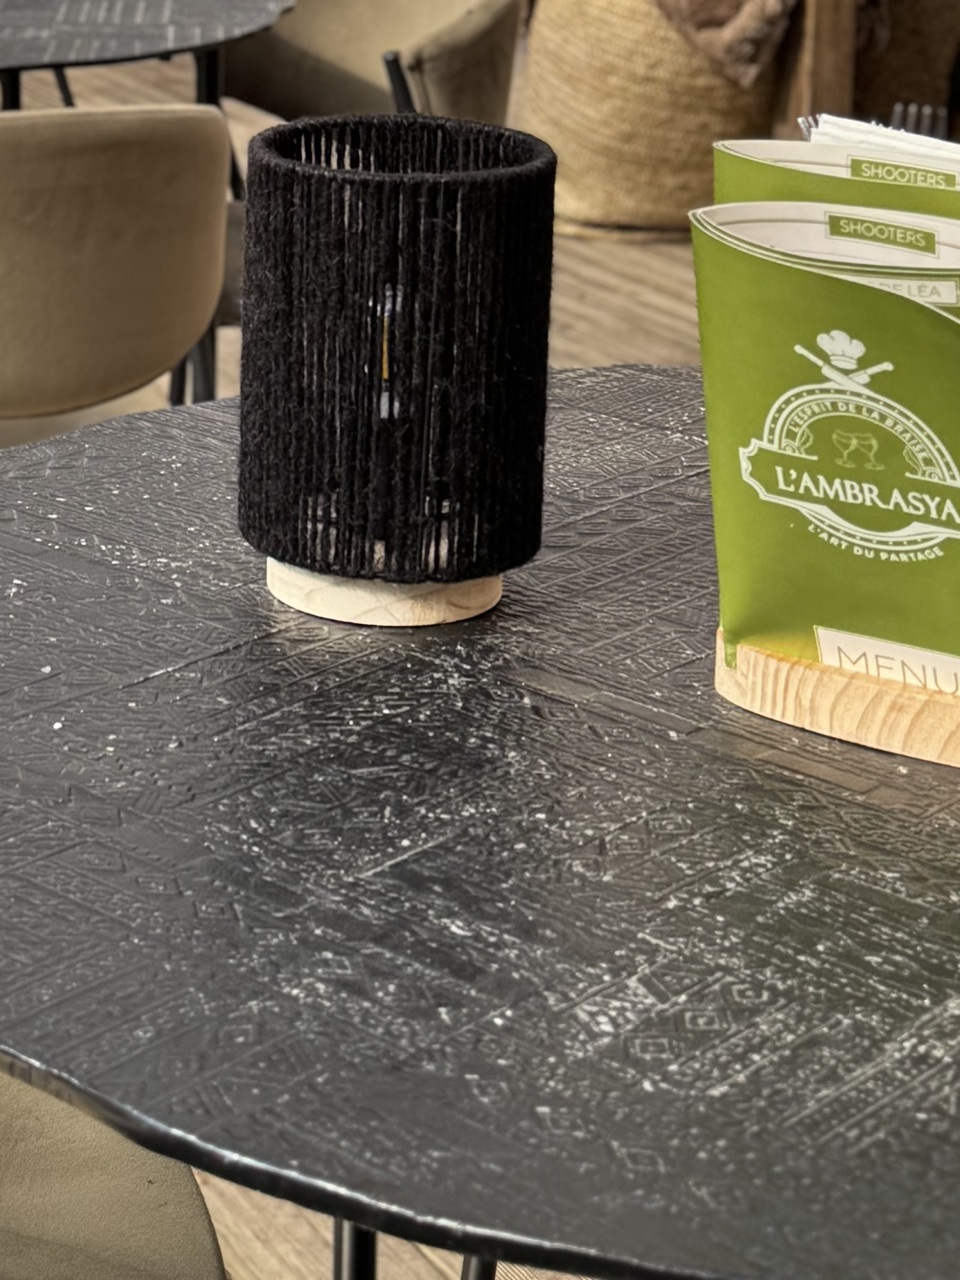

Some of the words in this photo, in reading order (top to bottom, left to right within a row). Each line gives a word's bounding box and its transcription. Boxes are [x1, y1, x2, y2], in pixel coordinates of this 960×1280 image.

[860, 163, 946, 188] SHOOTERS
[839, 219, 926, 247] SHOOTERS
[788, 401, 832, 433] L'ESPRIT
[838, 402, 856, 414] DE
[862, 407, 880, 420] LA
[884, 417, 928, 460] BRAISE
[774, 465, 960, 524] L'AMBRASYA
[808, 523, 849, 550] L'ART
[853, 546, 875, 559] DU
[880, 546, 945, 562] PARTAGE
[837, 645, 959, 695] MENU
